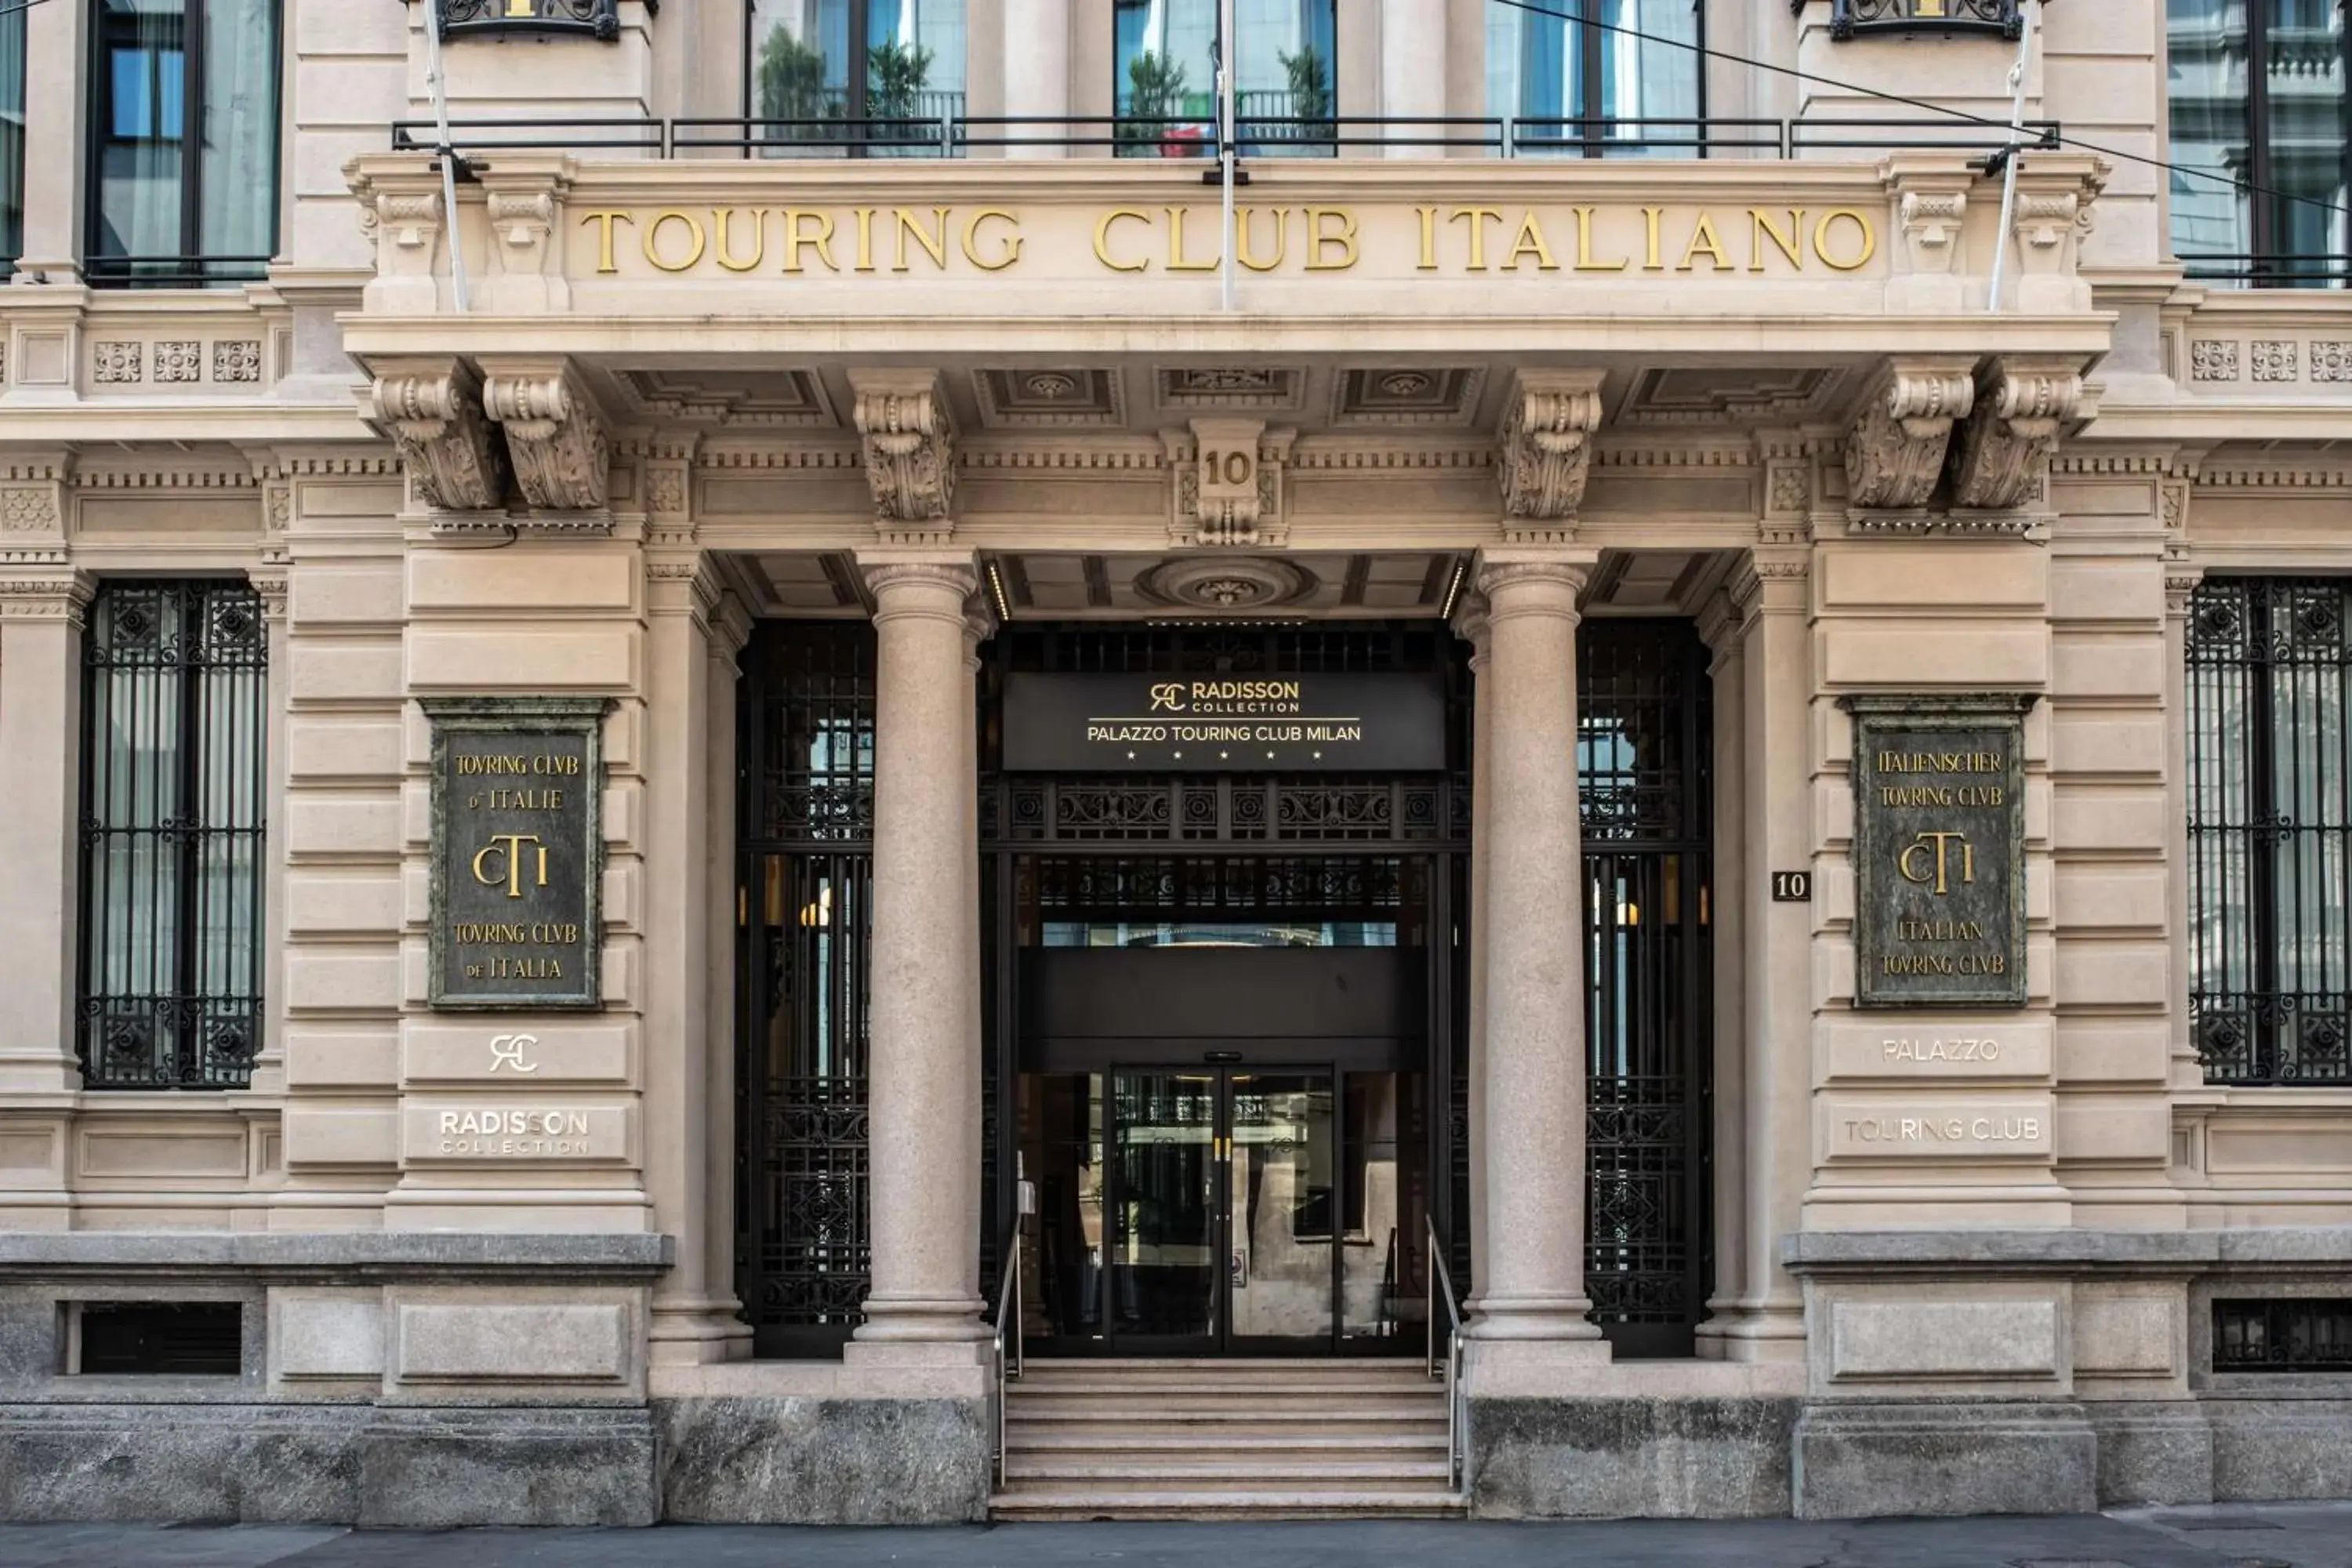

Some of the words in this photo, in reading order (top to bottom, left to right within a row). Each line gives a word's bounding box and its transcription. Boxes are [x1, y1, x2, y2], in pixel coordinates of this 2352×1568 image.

[581, 207, 1024, 274] TOURING
[1092, 206, 1359, 272] CLUB
[1415, 206, 1876, 273] ITALIANO
[1205, 451, 1250, 485] 10
[1192, 682, 1300, 699] RADISSON
[1192, 702, 1300, 713] COLLECTION
[1087, 727, 1167, 742] PALAZZO
[1171, 727, 1250, 742] TOURING
[1255, 727, 1301, 742] CLUB
[1307, 727, 1361, 742] MILAN
[456, 755, 527, 775] TOVRING
[533, 755, 579, 775] CLVB
[1878, 752, 2001, 772] ITALIENISCHER
[490, 789, 563, 809] ITALIE
[1880, 786, 1951, 806] TOVRING
[1958, 786, 2002, 806] CLVB
[1777, 874, 1806, 896] 10
[455, 924, 525, 944] TOVRING
[532, 924, 577, 944] CLVB
[1899, 920, 1984, 941] ITALIAN
[490, 959, 563, 979] ITALIA
[1882, 955, 1951, 975] TOVRING
[1958, 955, 2004, 975] CLVB
[1882, 1040, 1999, 1061] PALAZZO
[441, 1112, 588, 1135] RADISSON
[1846, 1119, 1963, 1141] TOURING
[1972, 1118, 2040, 1140] CLUB
[441, 1139, 589, 1155] COLLECTION
